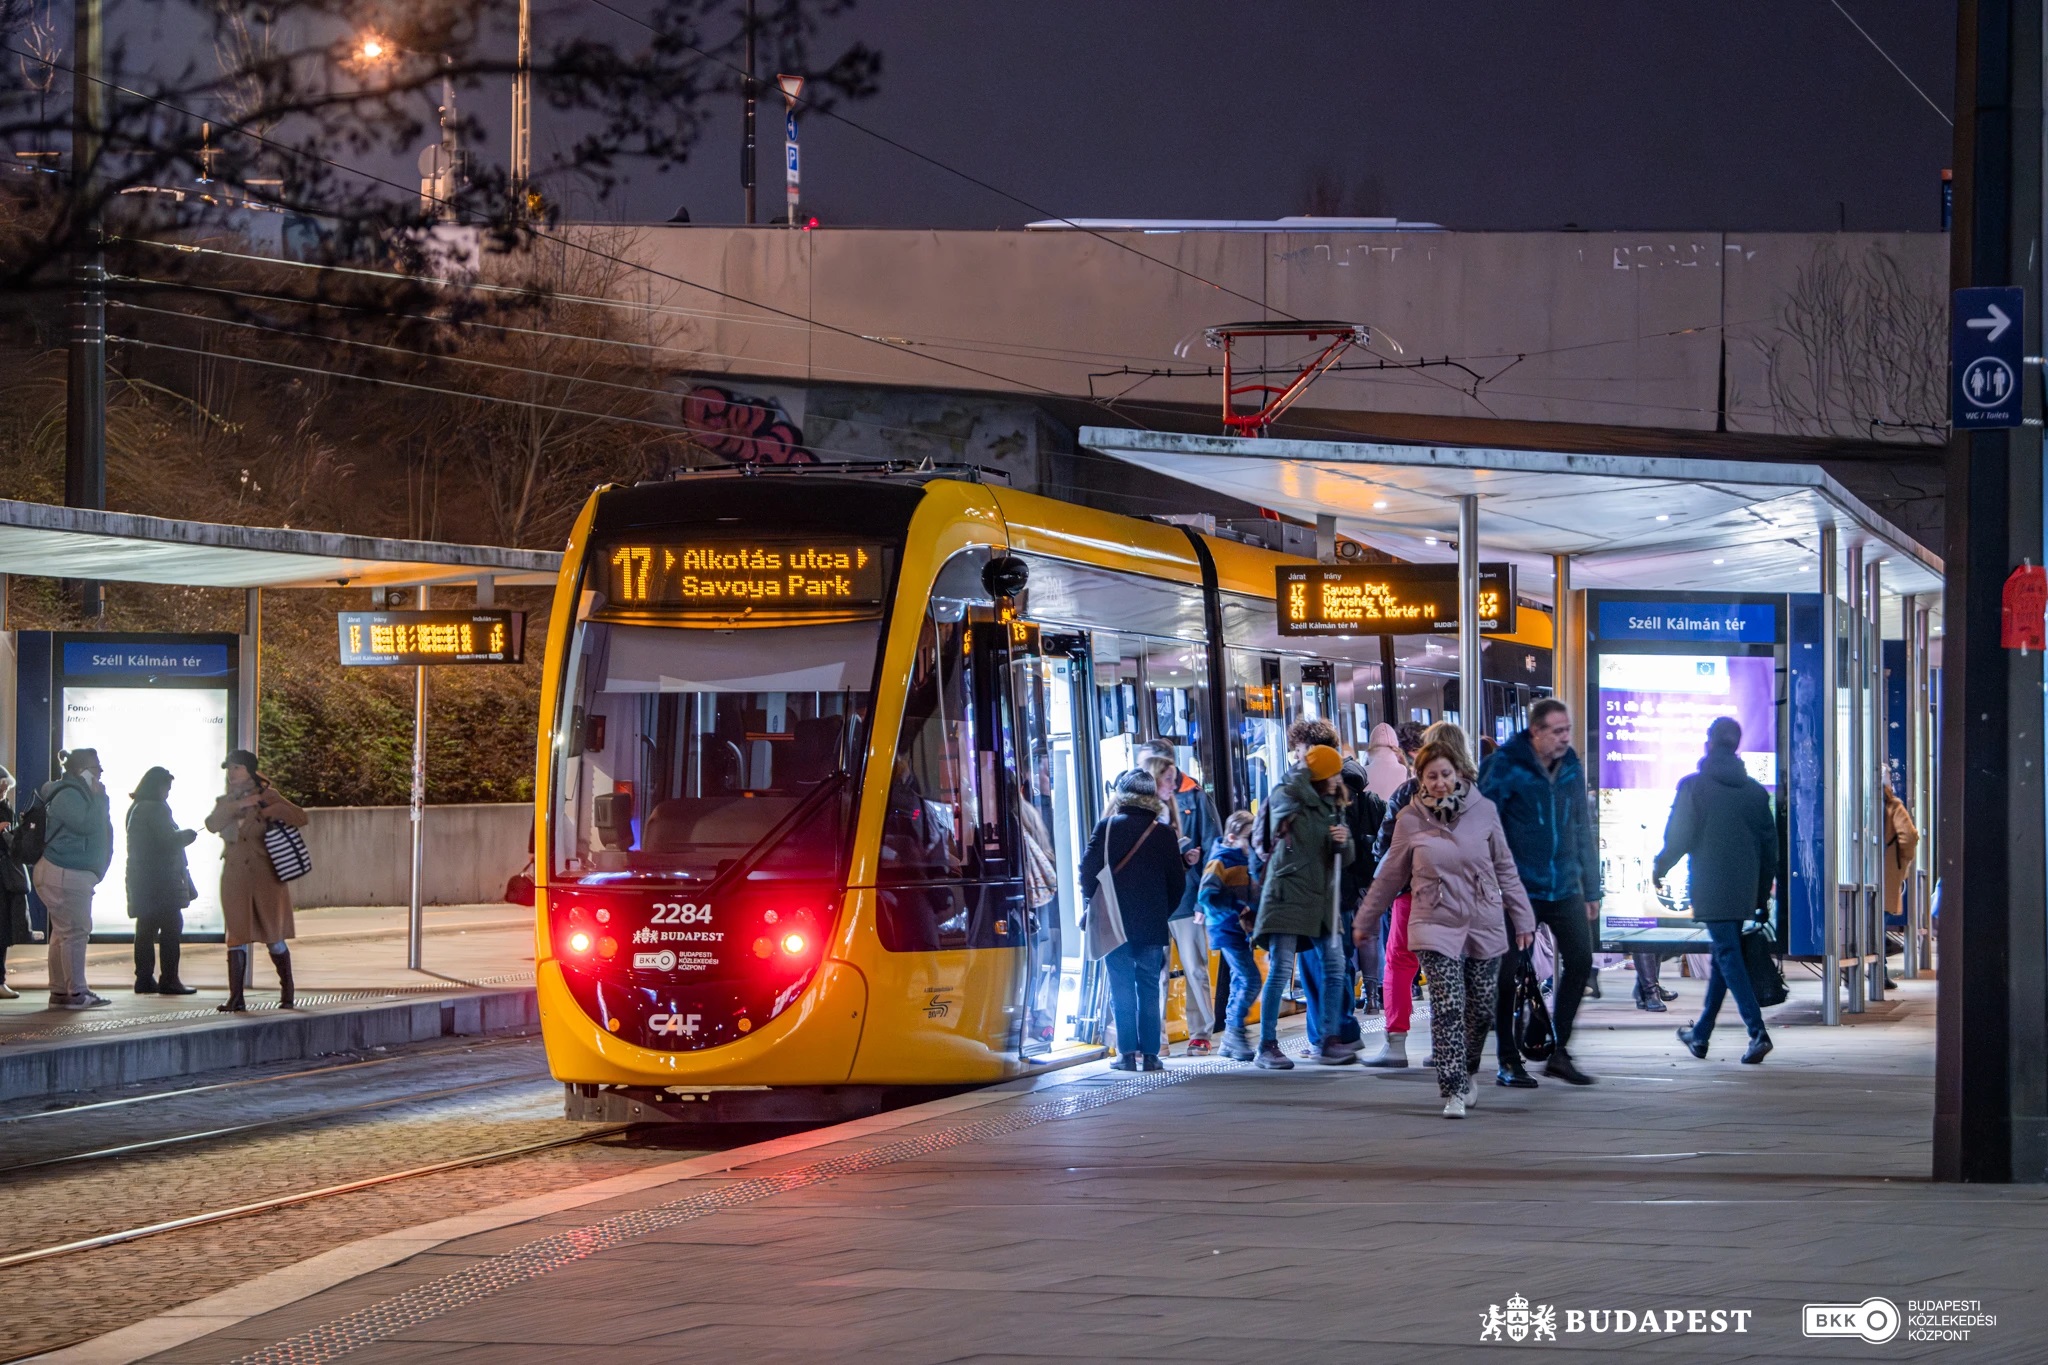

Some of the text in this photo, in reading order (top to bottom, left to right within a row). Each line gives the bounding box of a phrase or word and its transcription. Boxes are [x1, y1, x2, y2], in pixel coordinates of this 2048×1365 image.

[612, 547, 850, 600] 17 Alkotás utca
[1324, 572, 1342, 580] Irány
[682, 575, 850, 598] Savoya Park
[1290, 584, 1305, 596] 17
[1365, 584, 1390, 595] Park
[1290, 596, 1305, 607] 56
[1324, 595, 1375, 607] Városház
[1378, 595, 1397, 607] tér
[1291, 606, 1305, 619] 61
[1324, 606, 1362, 618] Móricz
[1366, 606, 1382, 618] Zs.
[1385, 604, 1420, 618] körtér
[1424, 605, 1435, 618] M
[1628, 616, 1746, 630] Széll Kálmán tér
[350, 625, 360, 634] 17
[350, 634, 361, 644] 17
[351, 643, 362, 653] 17
[92, 654, 202, 667] Széll Kálmán tér
[1606, 701, 1620, 711] 51
[650, 903, 713, 924] 2284
[660, 932, 724, 942] BUDAPEST
[648, 1014, 702, 1036] CAF
